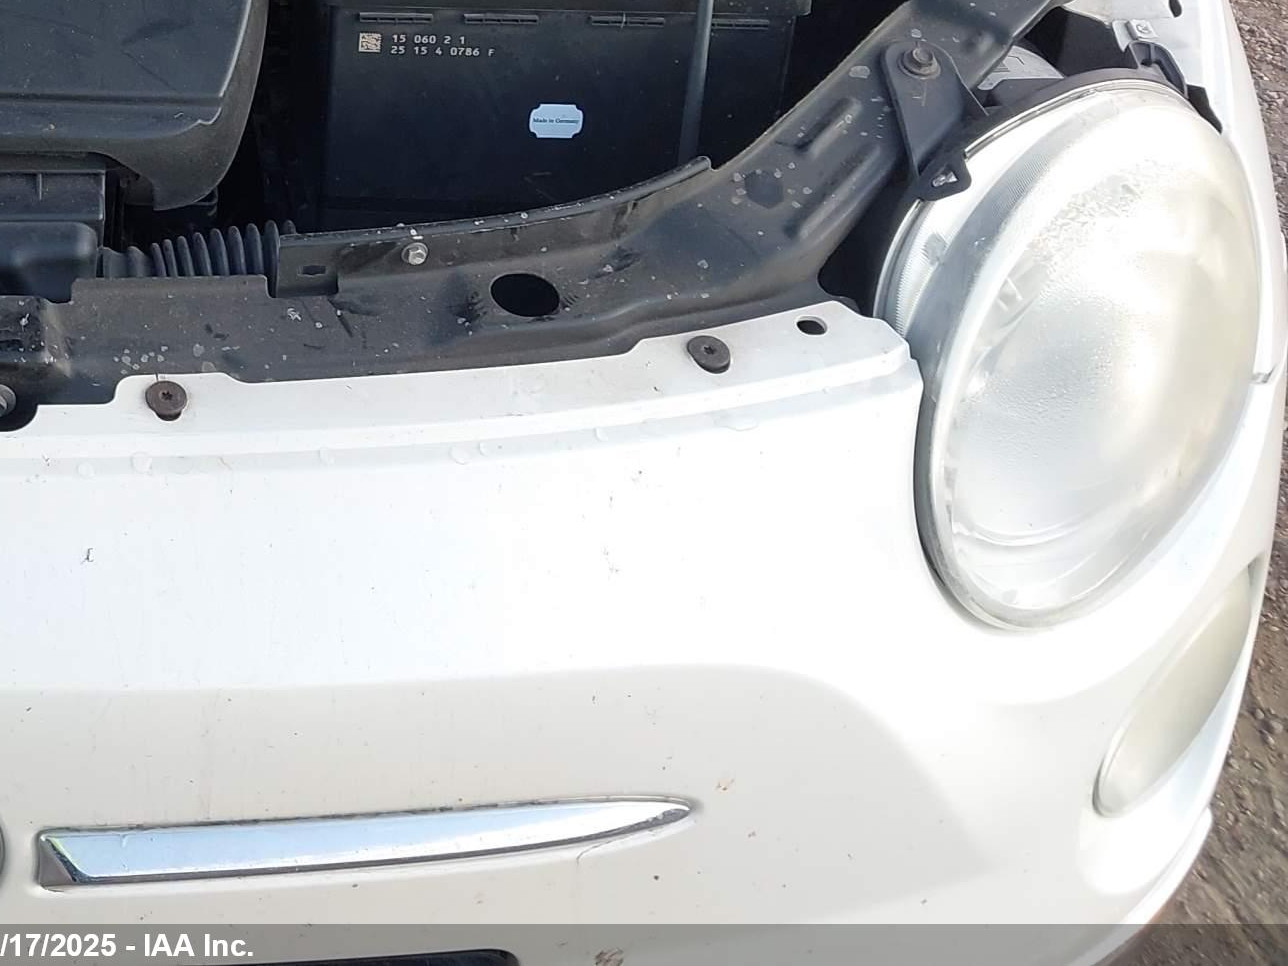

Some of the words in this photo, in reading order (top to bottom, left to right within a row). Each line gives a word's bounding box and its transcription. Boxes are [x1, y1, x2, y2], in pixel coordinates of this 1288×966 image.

[391, 34, 406, 44] 15
[413, 35, 437, 44] 060
[443, 35, 451, 44] 2
[459, 36, 466, 44] 1
[390, 45, 406, 54] 25
[413, 46, 428, 55] 15
[435, 47, 443, 55] 4
[450, 47, 480, 56] 0786
[488, 49, 495, 57] F
[555, 117, 580, 125] Germany
